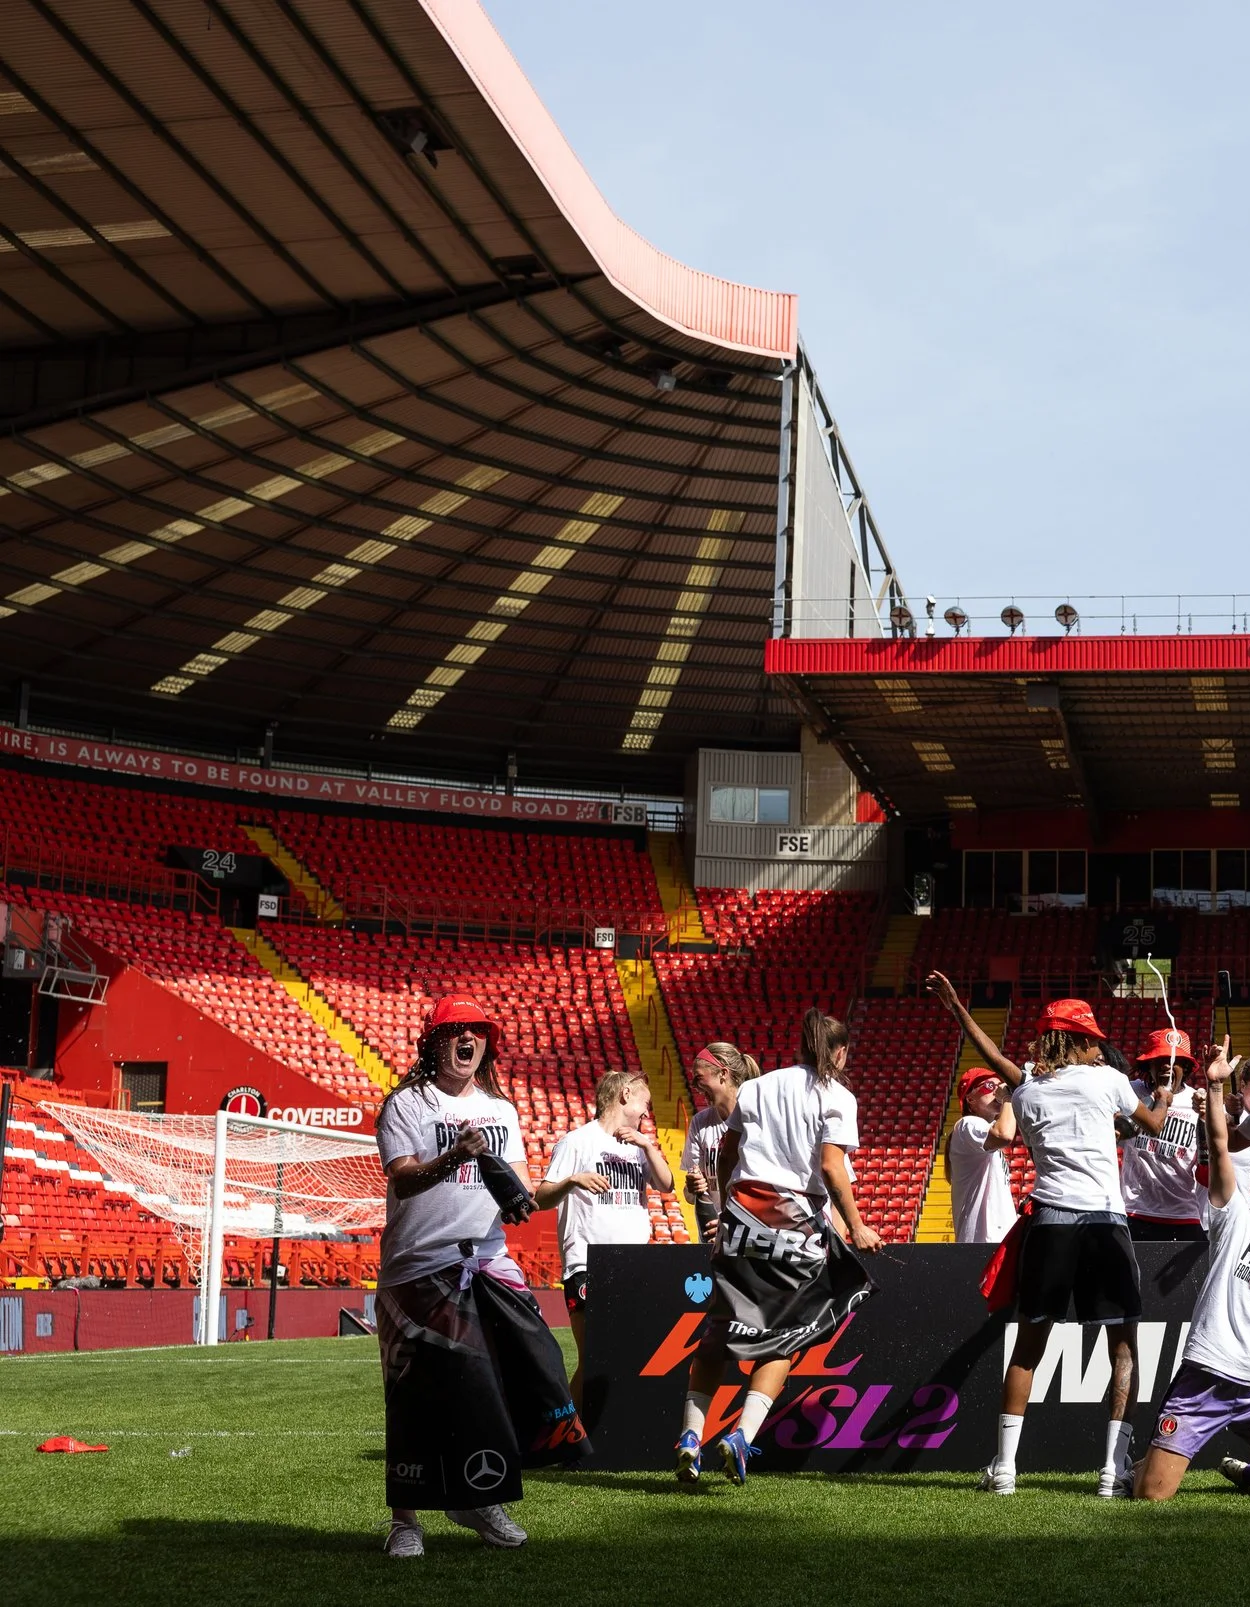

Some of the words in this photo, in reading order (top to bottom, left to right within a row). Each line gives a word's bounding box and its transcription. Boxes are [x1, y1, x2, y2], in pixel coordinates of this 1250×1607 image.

[0, 731, 39, 753] IRE,
[50, 741, 68, 757] IS
[78, 746, 161, 771] ALWAYS
[171, 760, 198, 776] TO
[208, 766, 230, 781] BE
[240, 770, 310, 791] FOUND
[320, 781, 345, 795] AT
[356, 785, 431, 804] VALLEY
[440, 794, 502, 812] FLOYD
[512, 801, 569, 816] ROAD
[613, 806, 645, 823] FSB
[779, 835, 809, 852] FSE
[202, 849, 237, 873] 24
[260, 899, 277, 910] FSD
[596, 932, 614, 942] FSD
[1122, 925, 1156, 945] 25
[227, 1086, 261, 1099] CHARLTON
[267, 1107, 363, 1127] COVERED
[728, 1320, 758, 1337] The
